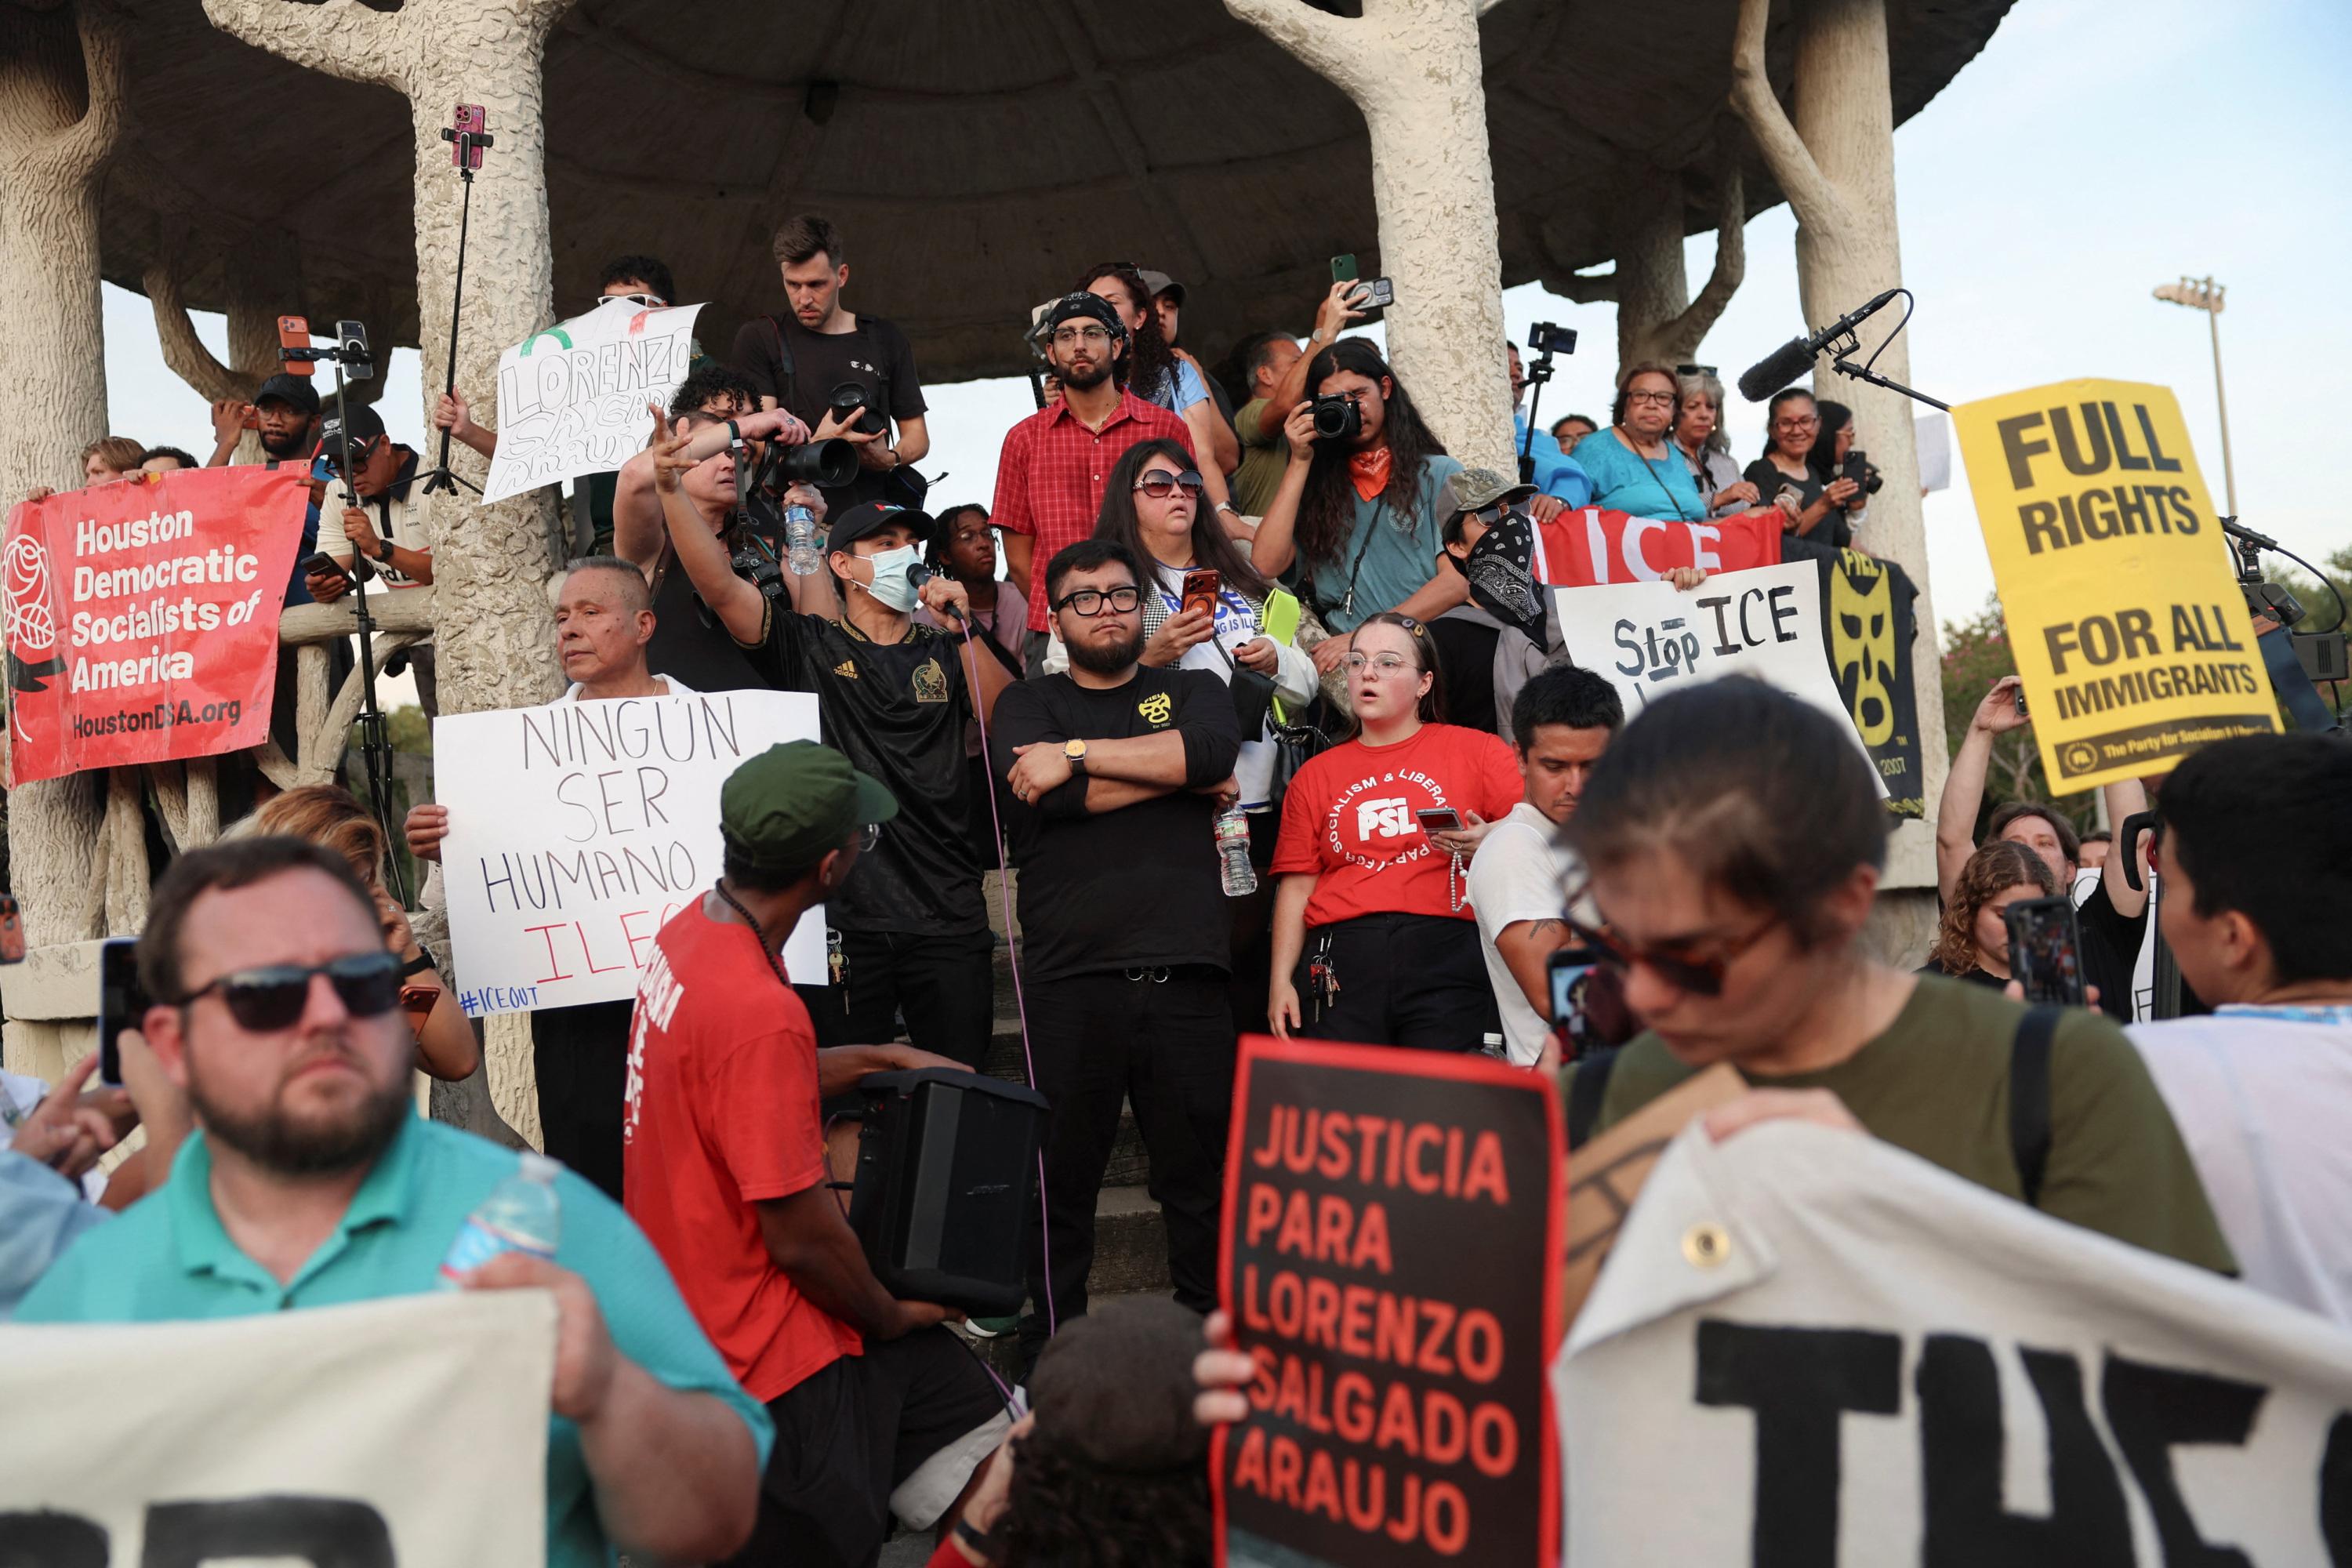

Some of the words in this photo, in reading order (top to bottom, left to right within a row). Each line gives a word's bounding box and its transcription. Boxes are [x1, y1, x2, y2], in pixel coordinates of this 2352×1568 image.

[501, 327, 691, 428] LORENZO
[1997, 401, 2183, 491] FULL
[76, 510, 193, 557] Houston
[1584, 510, 1722, 584] ICE
[2018, 485, 2199, 555] RIGHTS
[74, 544, 259, 601] Democratic
[71, 594, 220, 647] Socialists
[227, 589, 263, 626] of
[1614, 618, 1700, 681] Stop
[1696, 586, 1798, 657] ICE
[2043, 608, 2161, 676] FOR
[2170, 604, 2245, 652] ALL
[71, 644, 194, 693] America
[2054, 663, 2258, 720] IMMIGRANTS
[74, 699, 241, 739] HoustonDSA.org
[523, 696, 740, 770] NINGÚN
[1384, 772, 1394, 782] &
[1399, 768, 1450, 808] LIBERA
[1880, 757, 1907, 776] 2007
[557, 766, 669, 842] SER
[1329, 776, 1377, 853] SOCIALISM
[1356, 800, 1417, 841] PSL
[481, 840, 695, 913] HUMANO
[1377, 844, 1431, 871] PAR
[524, 903, 681, 983] ILE
[1254, 1105, 1509, 1206] JUSTICIA
[1246, 1184, 1392, 1275] PARA
[1243, 1264, 1504, 1384] LORENZO
[1248, 1344, 1519, 1478] SALGADO
[1232, 1427, 1469, 1555] ARAUJO
